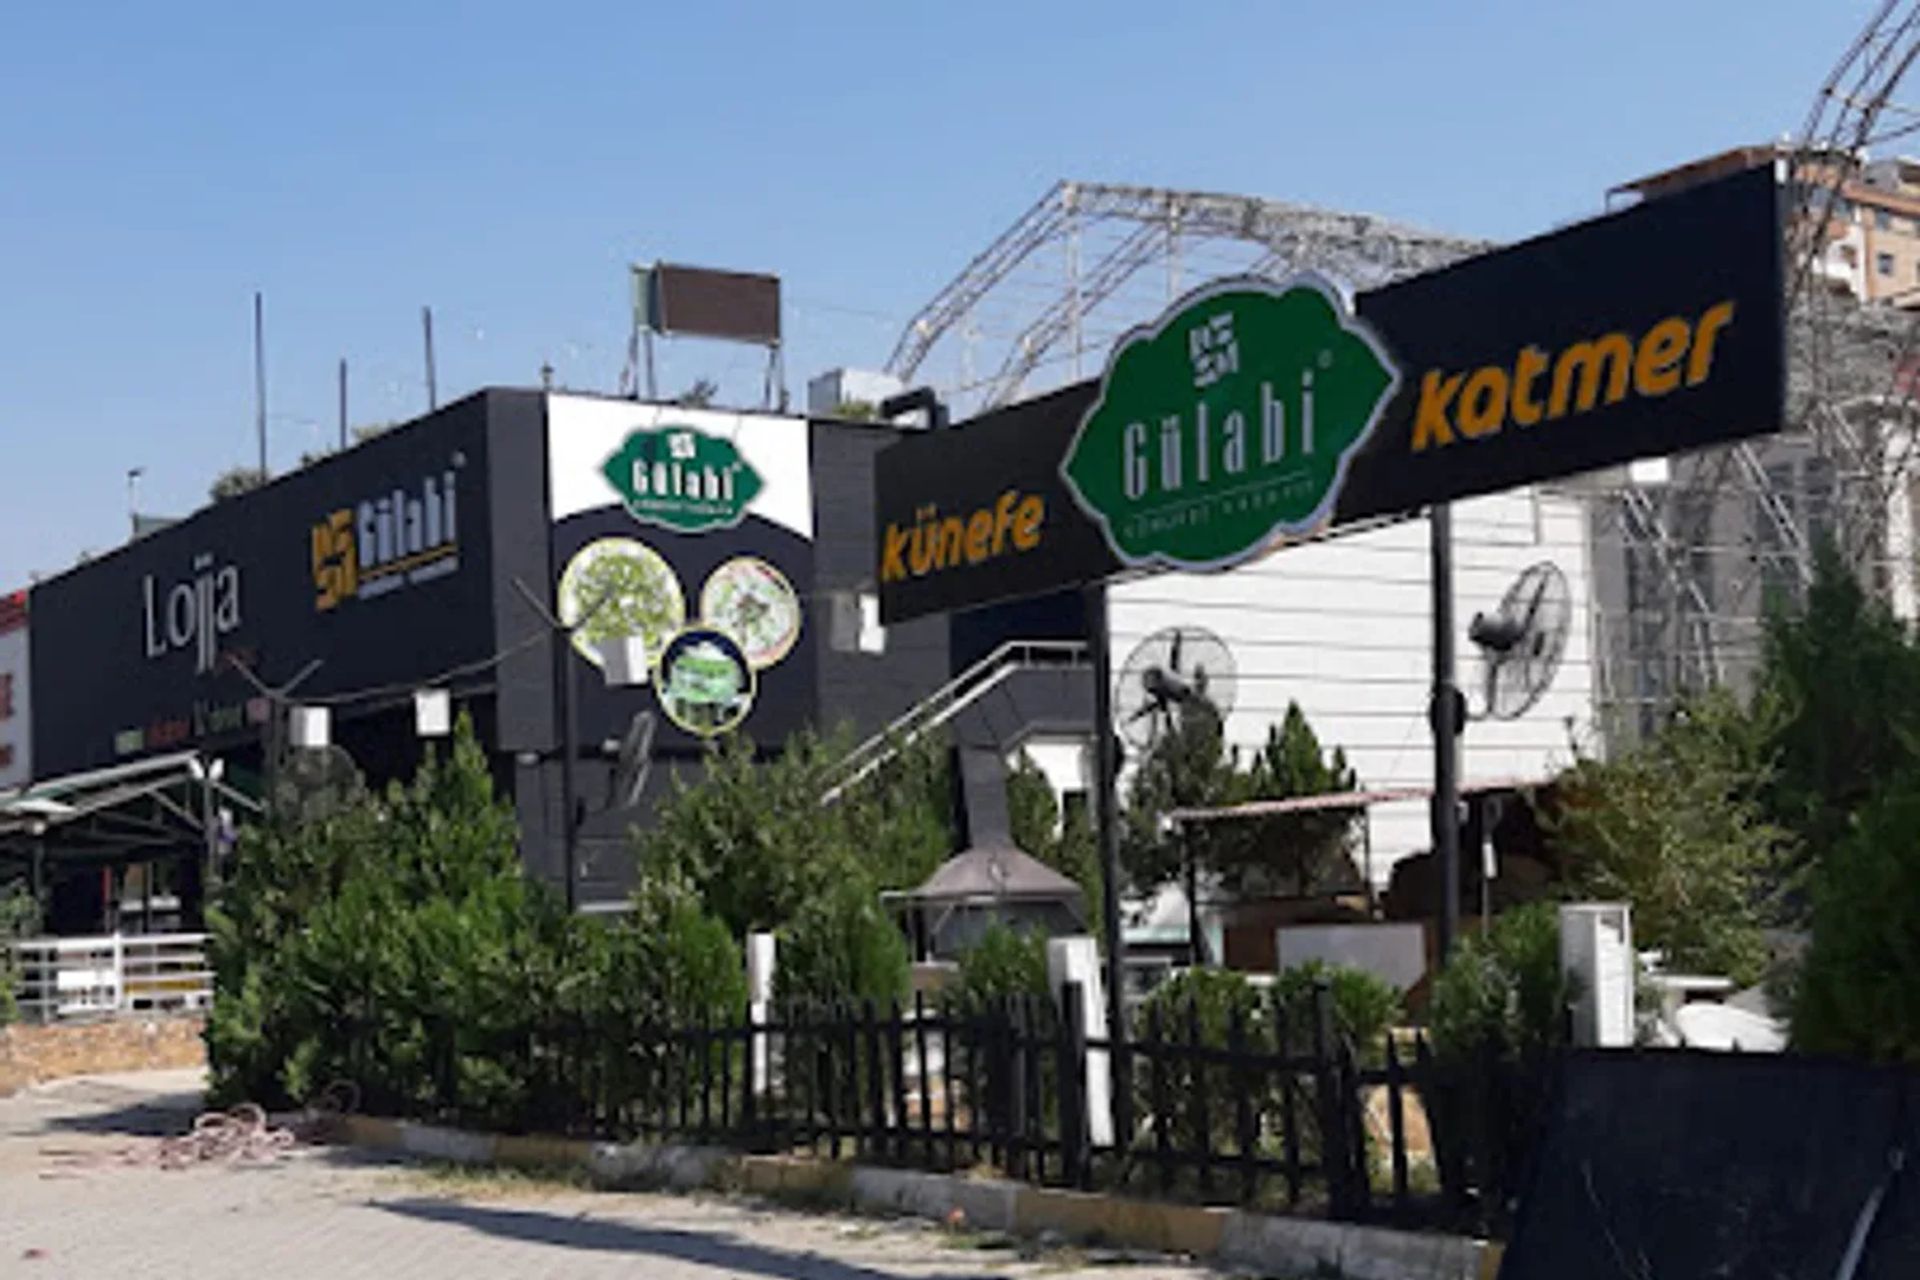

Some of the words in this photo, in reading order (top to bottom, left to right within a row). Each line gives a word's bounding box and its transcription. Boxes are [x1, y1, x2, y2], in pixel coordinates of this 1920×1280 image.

[1122, 368, 1317, 501] Gülabi
[1410, 300, 1735, 452] katmer
[880, 490, 1045, 582] künefe
